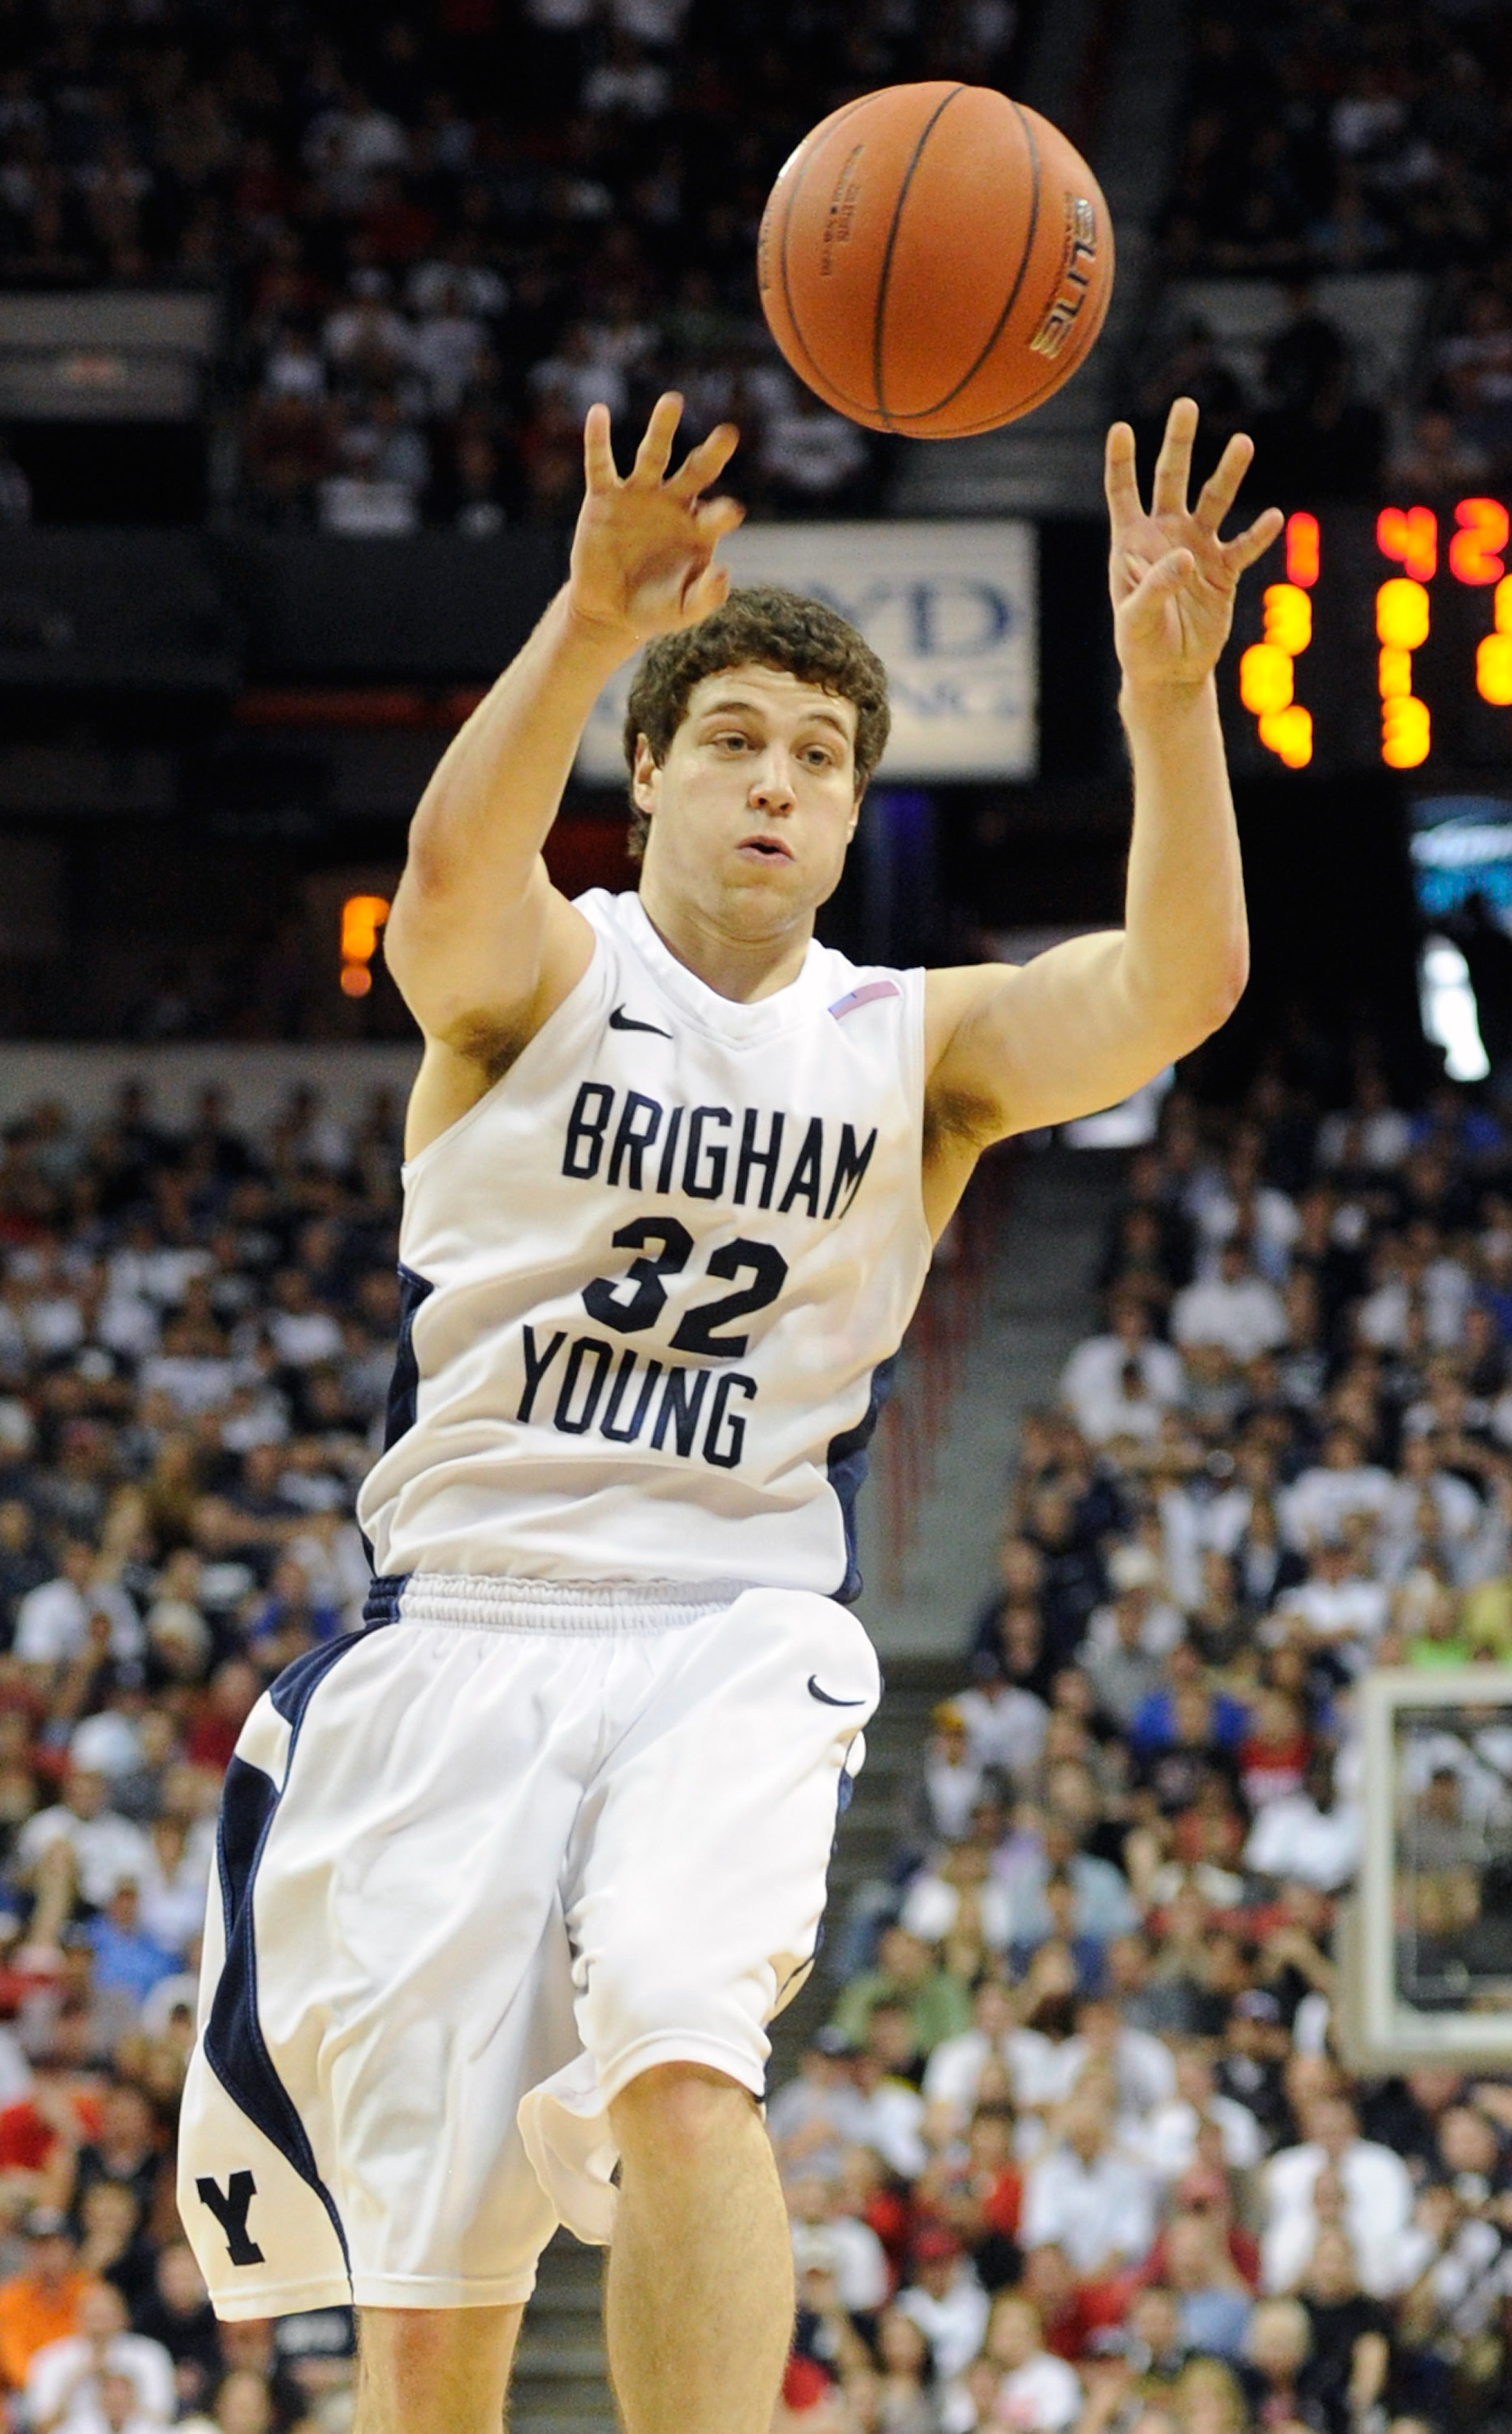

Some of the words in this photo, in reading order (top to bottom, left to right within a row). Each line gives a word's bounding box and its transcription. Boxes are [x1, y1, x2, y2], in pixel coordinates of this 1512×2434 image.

[1029, 197, 1098, 360] ELITE
[562, 1082, 878, 1220] BRIGHAM
[581, 1216, 789, 1358] 32
[516, 1324, 758, 1469] YOUNG
[195, 2170, 266, 2267] Y
